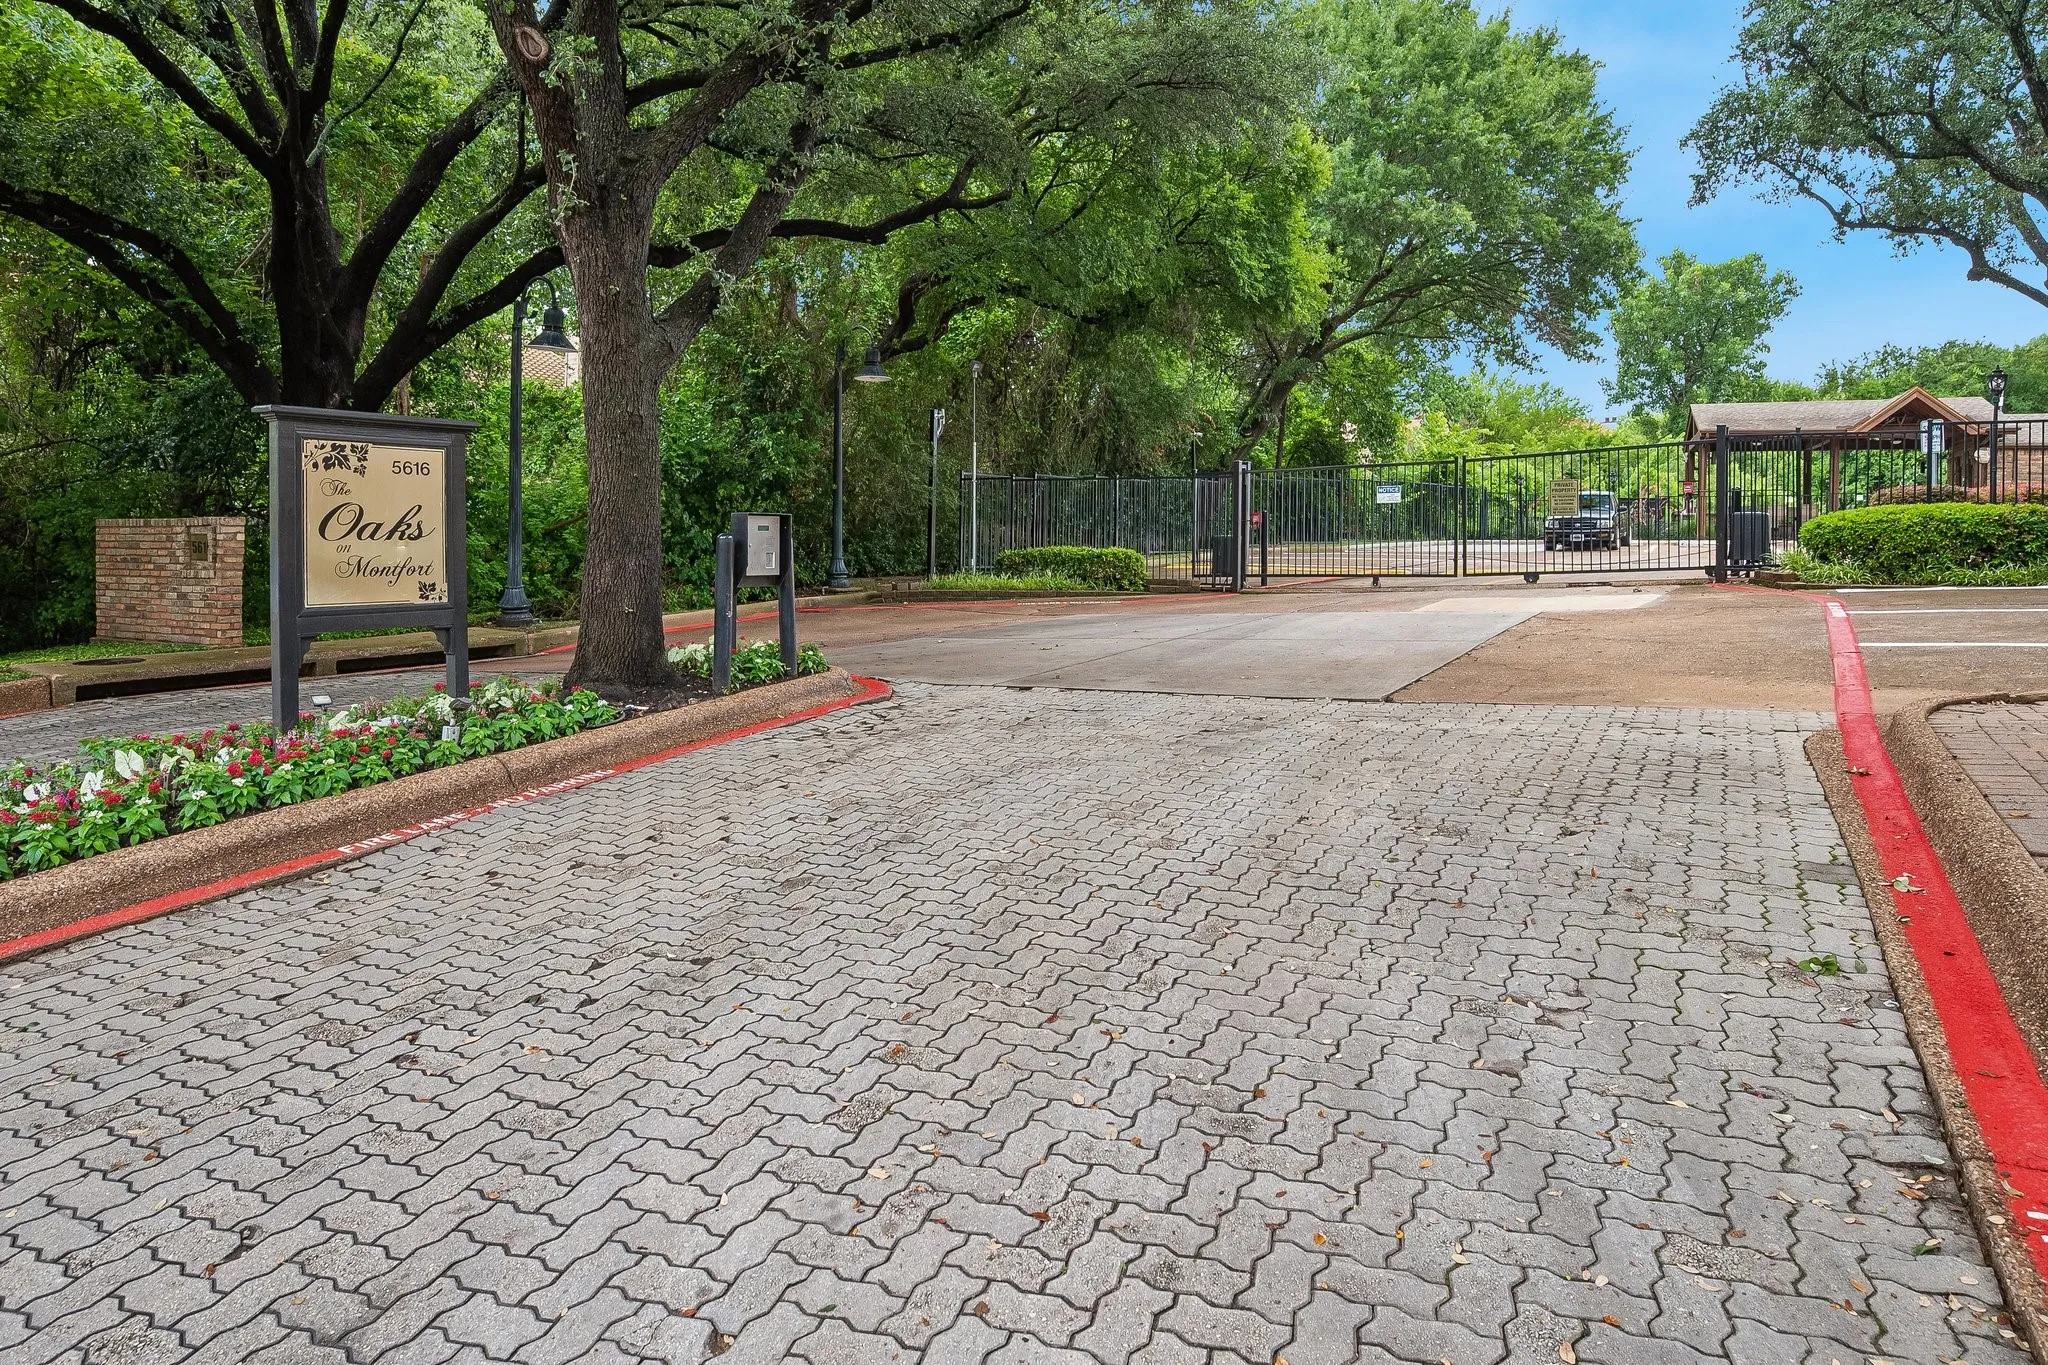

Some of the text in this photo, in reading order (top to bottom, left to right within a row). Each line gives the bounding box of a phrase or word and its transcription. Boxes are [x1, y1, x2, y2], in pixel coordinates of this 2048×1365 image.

[391, 461, 430, 476] 5616
[319, 477, 352, 497] The
[318, 501, 436, 542] Oaks
[192, 541, 208, 553] 561
[336, 543, 352, 554] on
[334, 554, 435, 587] Montfort
[337, 832, 404, 854] FIRE
[399, 812, 472, 834] LANE
[523, 768, 616, 797] PARKING
